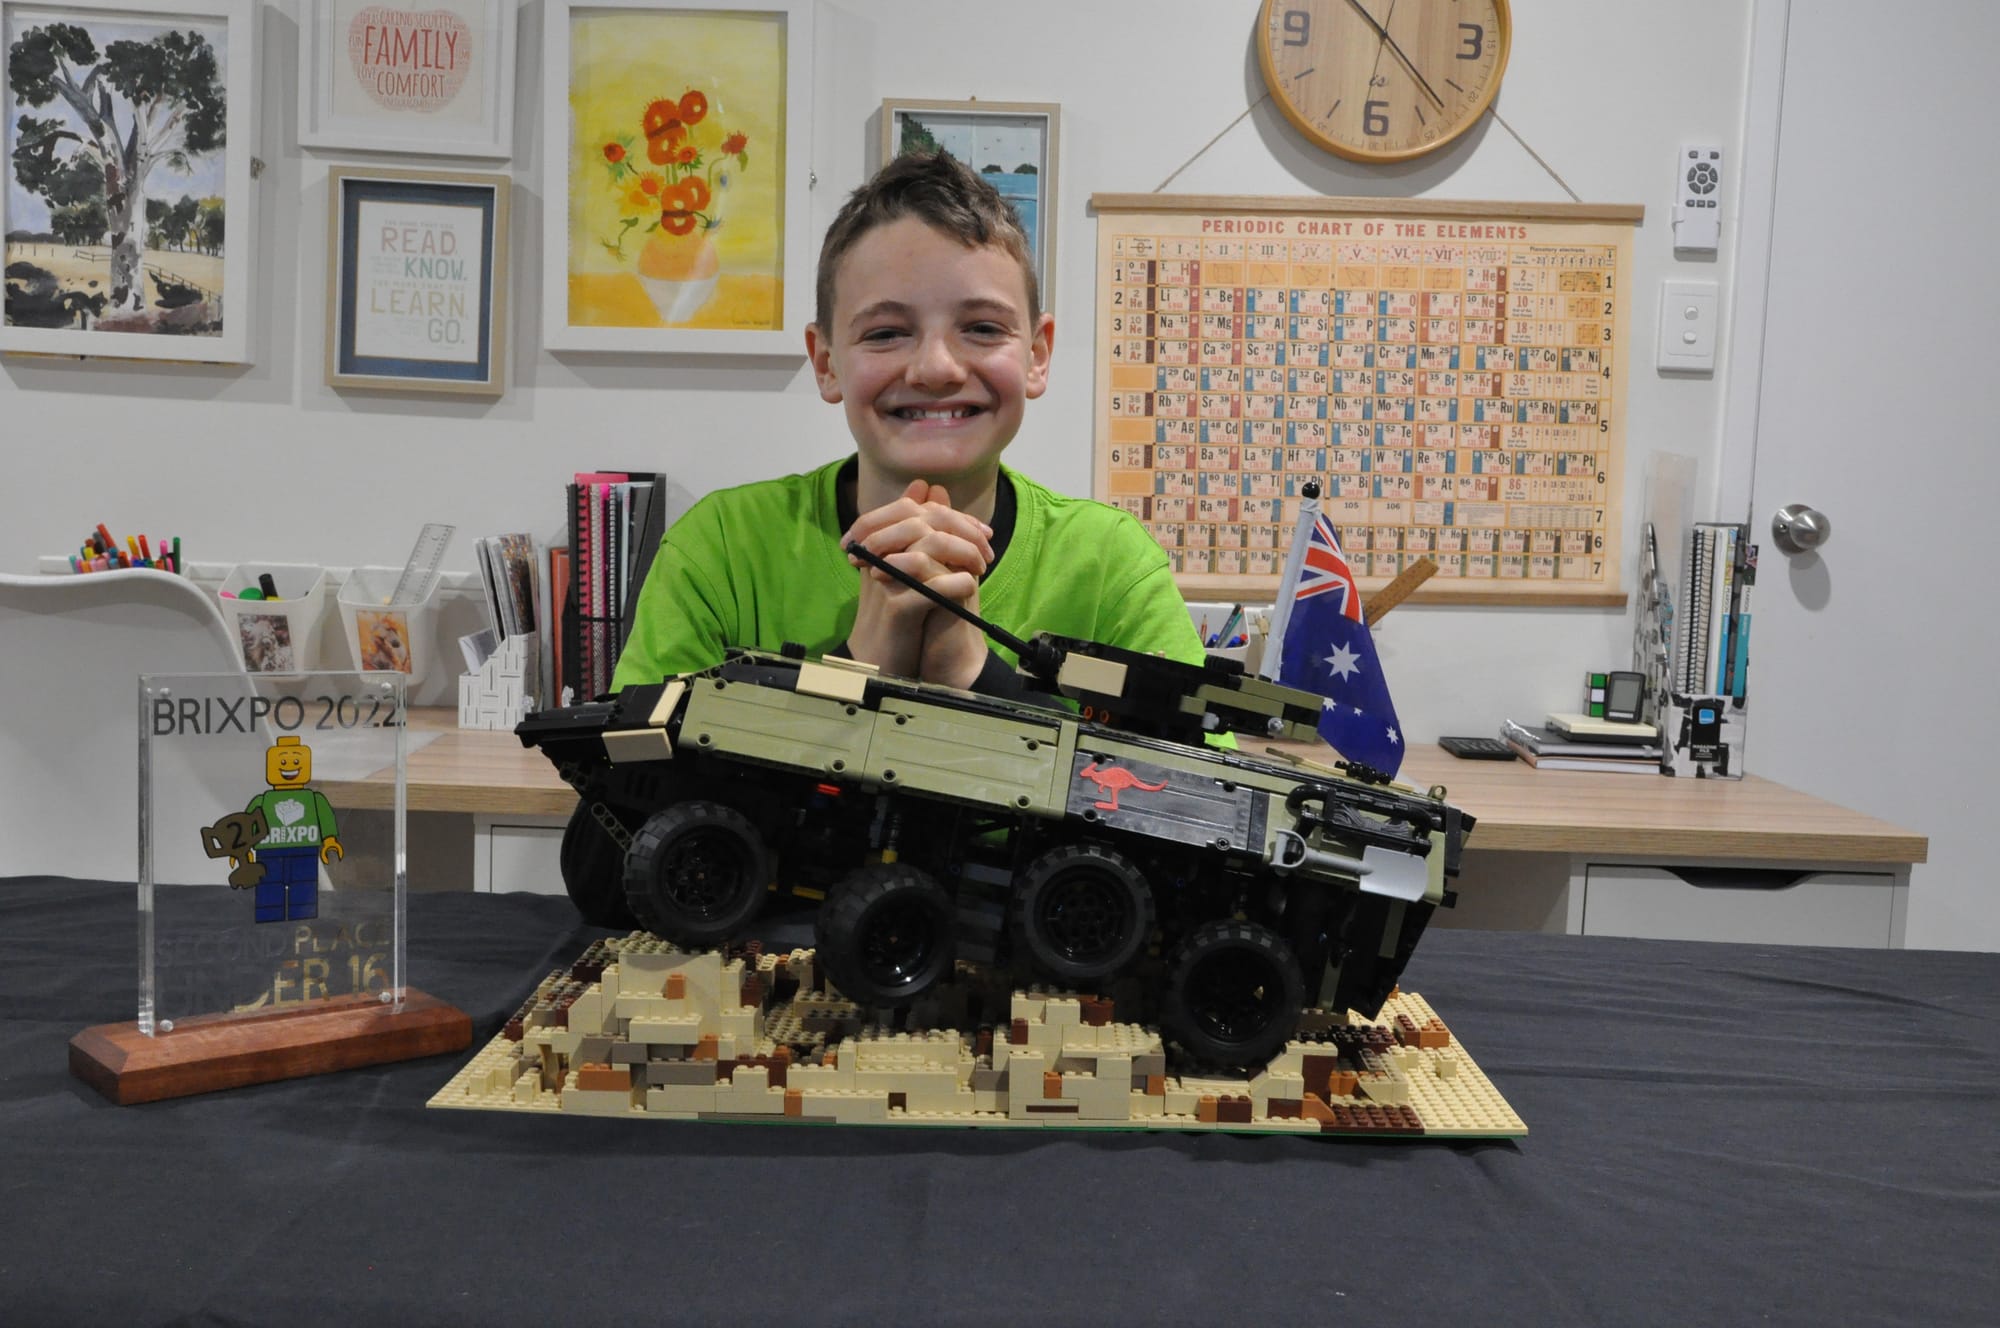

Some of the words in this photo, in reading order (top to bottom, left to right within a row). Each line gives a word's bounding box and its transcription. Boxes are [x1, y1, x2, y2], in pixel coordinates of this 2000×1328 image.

[380, 10, 412, 26] CARING
[1284, 10, 1310, 47] 9
[1456, 24, 1483, 60] 3
[364, 26, 458, 70] FAMILY
[377, 72, 445, 98] COMFORT
[1363, 100, 1389, 136] 6
[1203, 220, 1285, 232] PERIODIC
[1298, 222, 1352, 235] CHART
[1364, 223, 1383, 236] OF
[1395, 224, 1425, 237] THE
[1437, 225, 1527, 239] ELEMENTS
[381, 226, 458, 256] READ.
[1178, 245, 1182, 254] I
[1220, 246, 1228, 254] II
[1262, 246, 1274, 255] III
[1353, 249, 1360, 258] V
[1394, 248, 1407, 258] VI
[1436, 249, 1451, 259] VII
[404, 256, 467, 281] KNOW.
[1181, 265, 1189, 275] H
[1116, 270, 1122, 281] 1
[1483, 271, 1496, 281] He
[1521, 272, 1526, 280] 2
[1607, 276, 1612, 288] 1
[1114, 292, 1122, 304] 2
[1161, 290, 1170, 301] Li
[1220, 291, 1232, 301] Be
[1278, 292, 1284, 303] B
[1321, 294, 1328, 304] C
[1367, 294, 1373, 305] N
[370, 288, 468, 320] LEARN.
[1410, 297, 1415, 306] O
[1454, 297, 1458, 307] F
[1482, 297, 1494, 307] Ne
[1518, 298, 1528, 306] 10
[1604, 303, 1612, 314] 2
[1114, 319, 1122, 330] 3
[1160, 316, 1173, 327] Na
[1218, 317, 1232, 329] Mg
[1274, 318, 1284, 329] Al
[1317, 319, 1327, 330] Si
[1367, 320, 1372, 331] P
[1409, 322, 1415, 332] S
[428, 318, 464, 344] GO.
[1481, 323, 1493, 334] Ar
[1517, 324, 1527, 333] 18
[1604, 329, 1611, 341] 3
[1114, 345, 1121, 357] 4
[1160, 343, 1166, 354] K
[1204, 344, 1216, 355] Ca
[1247, 344, 1259, 355] Sc
[1292, 344, 1301, 356] Ti
[1337, 345, 1342, 357] V
[1380, 347, 1390, 358] Cr
[1421, 349, 1434, 359] Mn
[1503, 350, 1514, 361] Fe
[1544, 351, 1556, 362] Co
[1588, 352, 1598, 363] Ni
[1183, 370, 1195, 381] Cu
[1228, 371, 1238, 381] Zn
[1270, 372, 1282, 382] Ga
[1314, 372, 1325, 383] Ge
[1360, 373, 1371, 384] As
[1603, 367, 1610, 379] 4
[1402, 374, 1413, 385] Se
[1445, 375, 1456, 385] Br
[1480, 376, 1490, 387] Kr
[1513, 375, 1526, 385] 36
[1113, 398, 1120, 410] 5
[1159, 396, 1171, 406] Rb
[1203, 396, 1212, 407] Sr
[1246, 397, 1252, 408] Y
[1290, 398, 1299, 409] Zr
[1335, 398, 1347, 410] Nb
[1378, 399, 1391, 410] Mo
[1421, 401, 1430, 412] Tc
[1501, 402, 1512, 413] Ru
[1542, 403, 1554, 414] Rh
[1585, 404, 1596, 415] Pd
[1181, 422, 1194, 434] Ag
[1226, 423, 1238, 434] Cd
[1272, 424, 1281, 435] In
[1313, 425, 1324, 436] Sn
[1358, 426, 1369, 437] Sb
[1600, 420, 1608, 432] 5
[1402, 427, 1411, 437] Te
[1450, 428, 1453, 438] I
[1512, 428, 1523, 437] 54
[1112, 450, 1119, 461] 6
[1158, 448, 1170, 459] Cs
[1201, 449, 1213, 460] Ba
[1244, 450, 1255, 460] La
[1288, 450, 1299, 461] Hf
[1334, 451, 1344, 462] Ta
[1376, 451, 1384, 462] W
[1418, 453, 1429, 464] Re
[1499, 455, 1510, 466] Os
[1544, 455, 1552, 466] Ir
[1583, 456, 1594, 467] Pt
[1181, 474, 1193, 485] Au
[1224, 475, 1237, 487] Hg
[1359, 477, 1368, 488] Bi
[1598, 472, 1605, 484] 6
[1398, 479, 1410, 489] Po
[1441, 480, 1452, 490] At
[1475, 480, 1487, 491] Rn
[1509, 479, 1521, 490] 86
[1157, 501, 1167, 511] Fr
[1200, 502, 1212, 512] Ra
[1244, 502, 1255, 512] Ac
[1596, 511, 1602, 523] 7
[1595, 537, 1602, 548] 6
[1594, 563, 1600, 574] 7
[153, 696, 304, 735] BRIXPO
[316, 695, 397, 730] 2022
[226, 822, 246, 849] 2
[347, 953, 388, 994] 16
